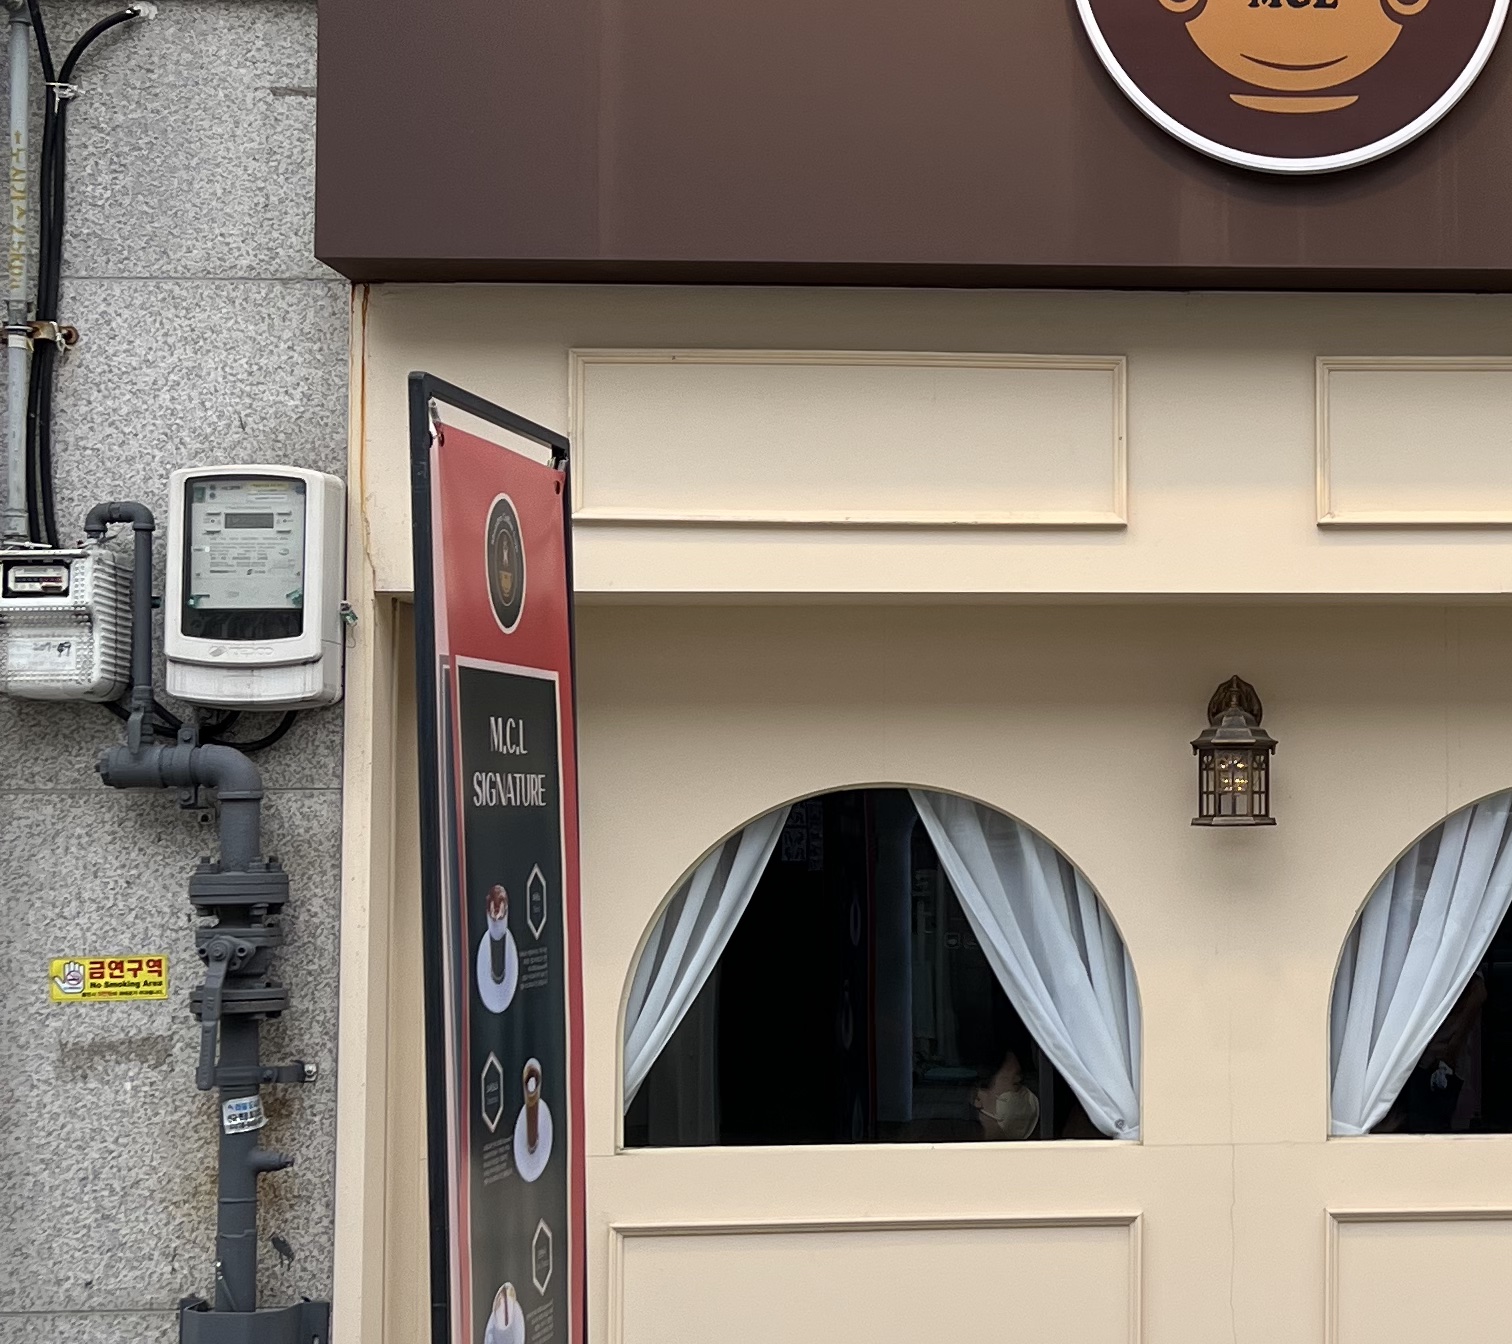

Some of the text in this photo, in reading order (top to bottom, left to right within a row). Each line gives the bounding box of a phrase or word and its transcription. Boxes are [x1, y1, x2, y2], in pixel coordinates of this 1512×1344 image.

[473, 771, 547, 807] SIGNATURE
[88, 958, 163, 980] 금연구역
[90, 980, 163, 989] No Smoking Area
